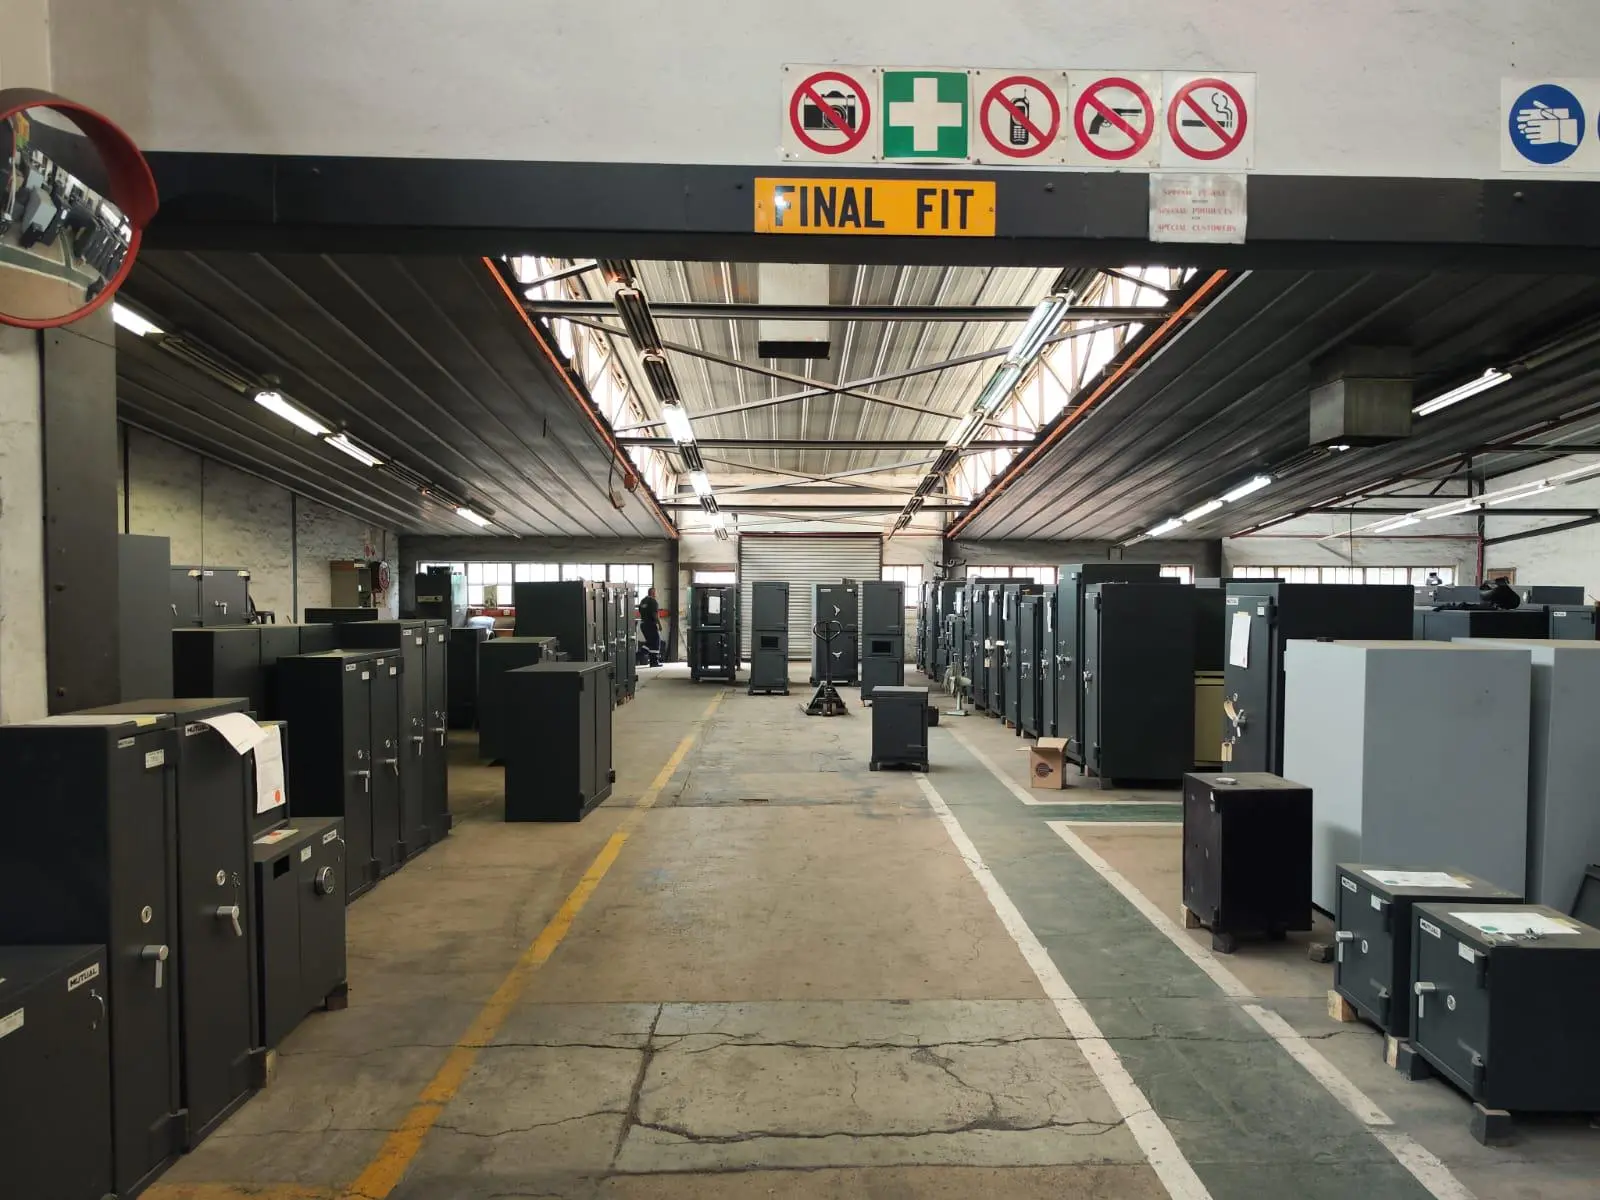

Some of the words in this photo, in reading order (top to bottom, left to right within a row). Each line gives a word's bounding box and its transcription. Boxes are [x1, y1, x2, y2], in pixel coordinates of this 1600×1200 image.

[775, 186, 885, 228] FINAL
[917, 188, 974, 229] FIT
[1157, 223, 1187, 231] SPECIAL
[1192, 224, 1237, 232] CUSTOMERS
[69, 967, 98, 988] MUTUAL
